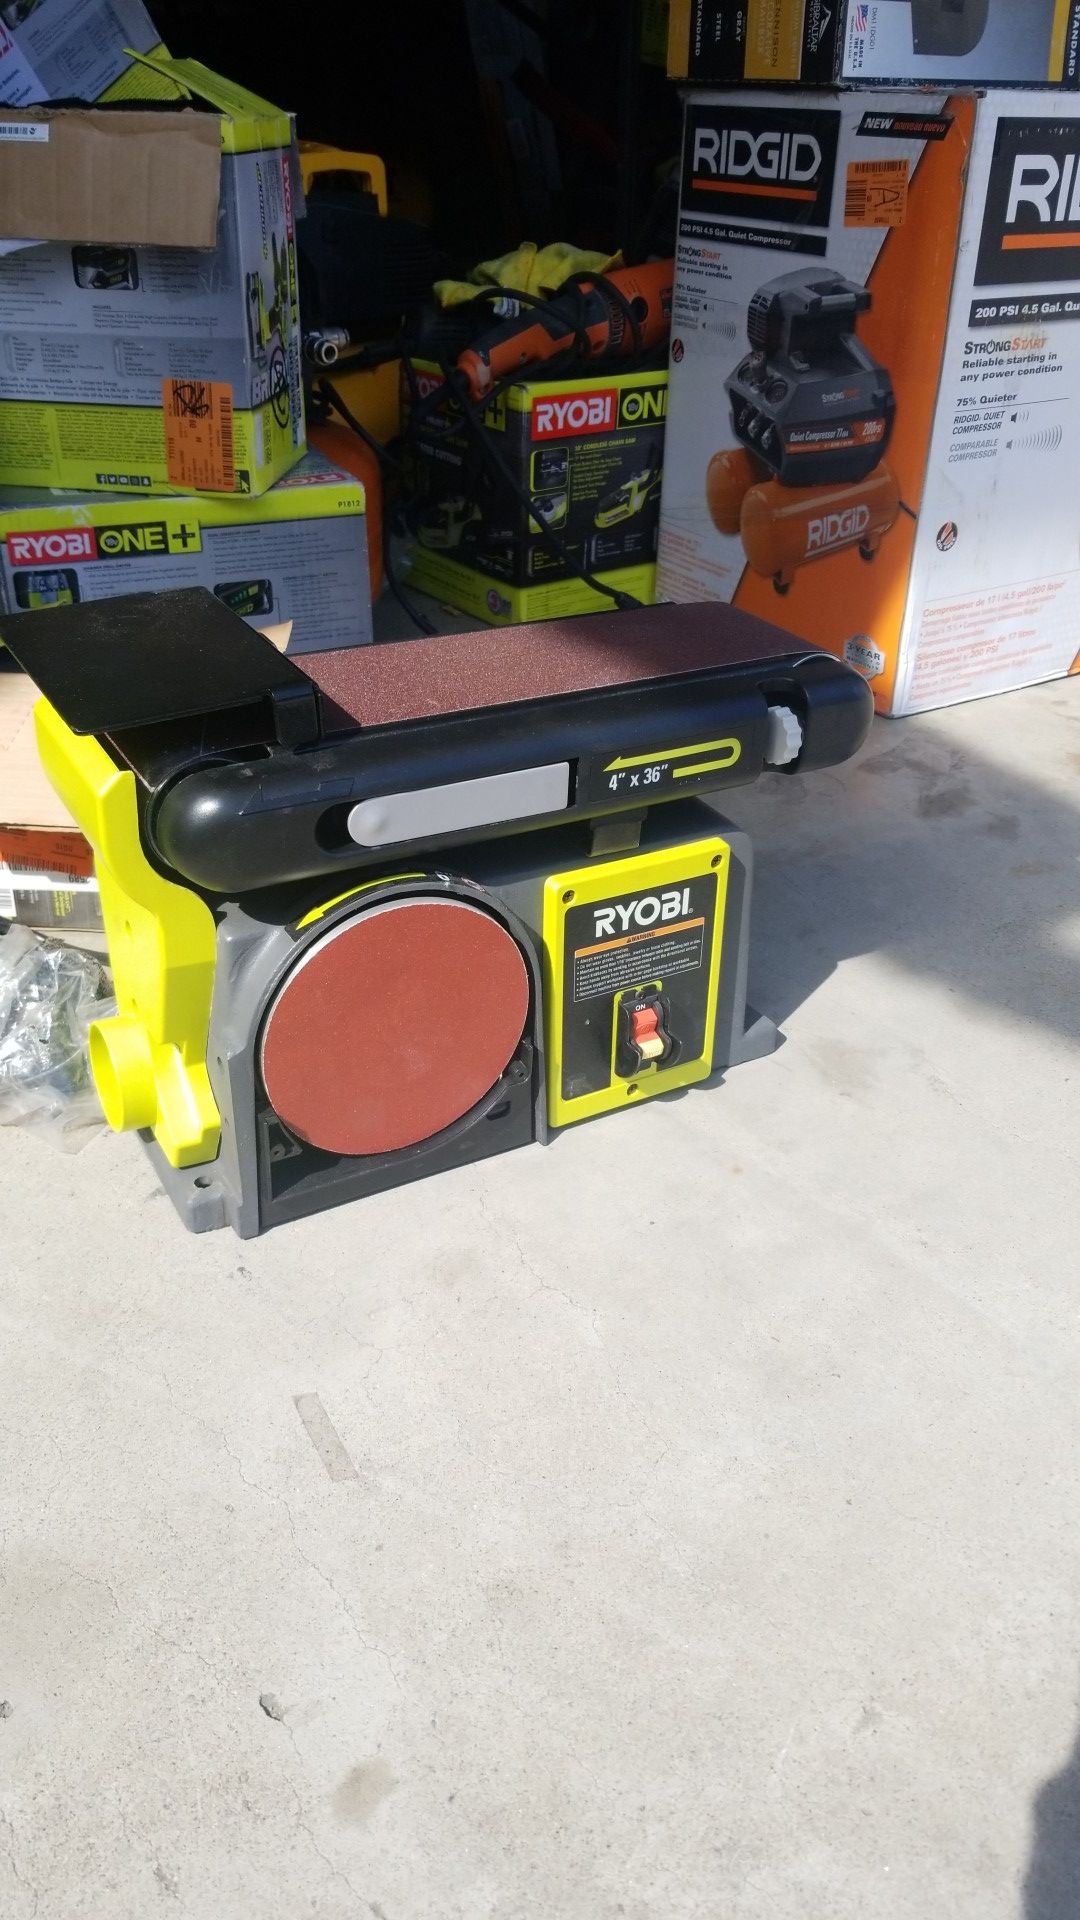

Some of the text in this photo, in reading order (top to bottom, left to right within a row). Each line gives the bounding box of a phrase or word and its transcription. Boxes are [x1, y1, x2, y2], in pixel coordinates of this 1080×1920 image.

[714, 12, 722, 42] STEEL
[735, 11, 743, 42] GRAY
[1068, 4, 1080, 76] STANDARD
[864, 117, 894, 129] NEW
[692, 128, 822, 182] RIDGID
[692, 225, 703, 233] PSI
[703, 227, 714, 235] 4.5
[728, 230, 747, 240] Quiet
[748, 233, 792, 246] Compressor
[705, 270, 733, 280] condition
[975, 307, 997, 318] 200
[999, 305, 1019, 317] PSI
[1021, 303, 1039, 315] 4.5
[1040, 302, 1062, 313] Gal.
[962, 352, 1058, 369] Reliable starting in
[960, 364, 1063, 382] any power condition
[621, 387, 668, 421] ON
[956, 393, 1018, 407] 75% Quieter
[535, 396, 614, 433] RYOBI
[983, 410, 1006, 421] QUIET
[805, 430, 837, 442] Compressor
[952, 421, 1003, 435] COMPRESSOR
[950, 438, 999, 453] COMPARABLE
[948, 449, 998, 463] COMPRESSOR
[808, 505, 870, 550] RIDGID
[10, 532, 92, 560] RYOBI
[629, 774, 639, 787] x
[642, 764, 669, 784] 36"
[593, 886, 691, 938] RYOBI
[631, 931, 656, 942] WARNING
[635, 1003, 646, 1011] ON
